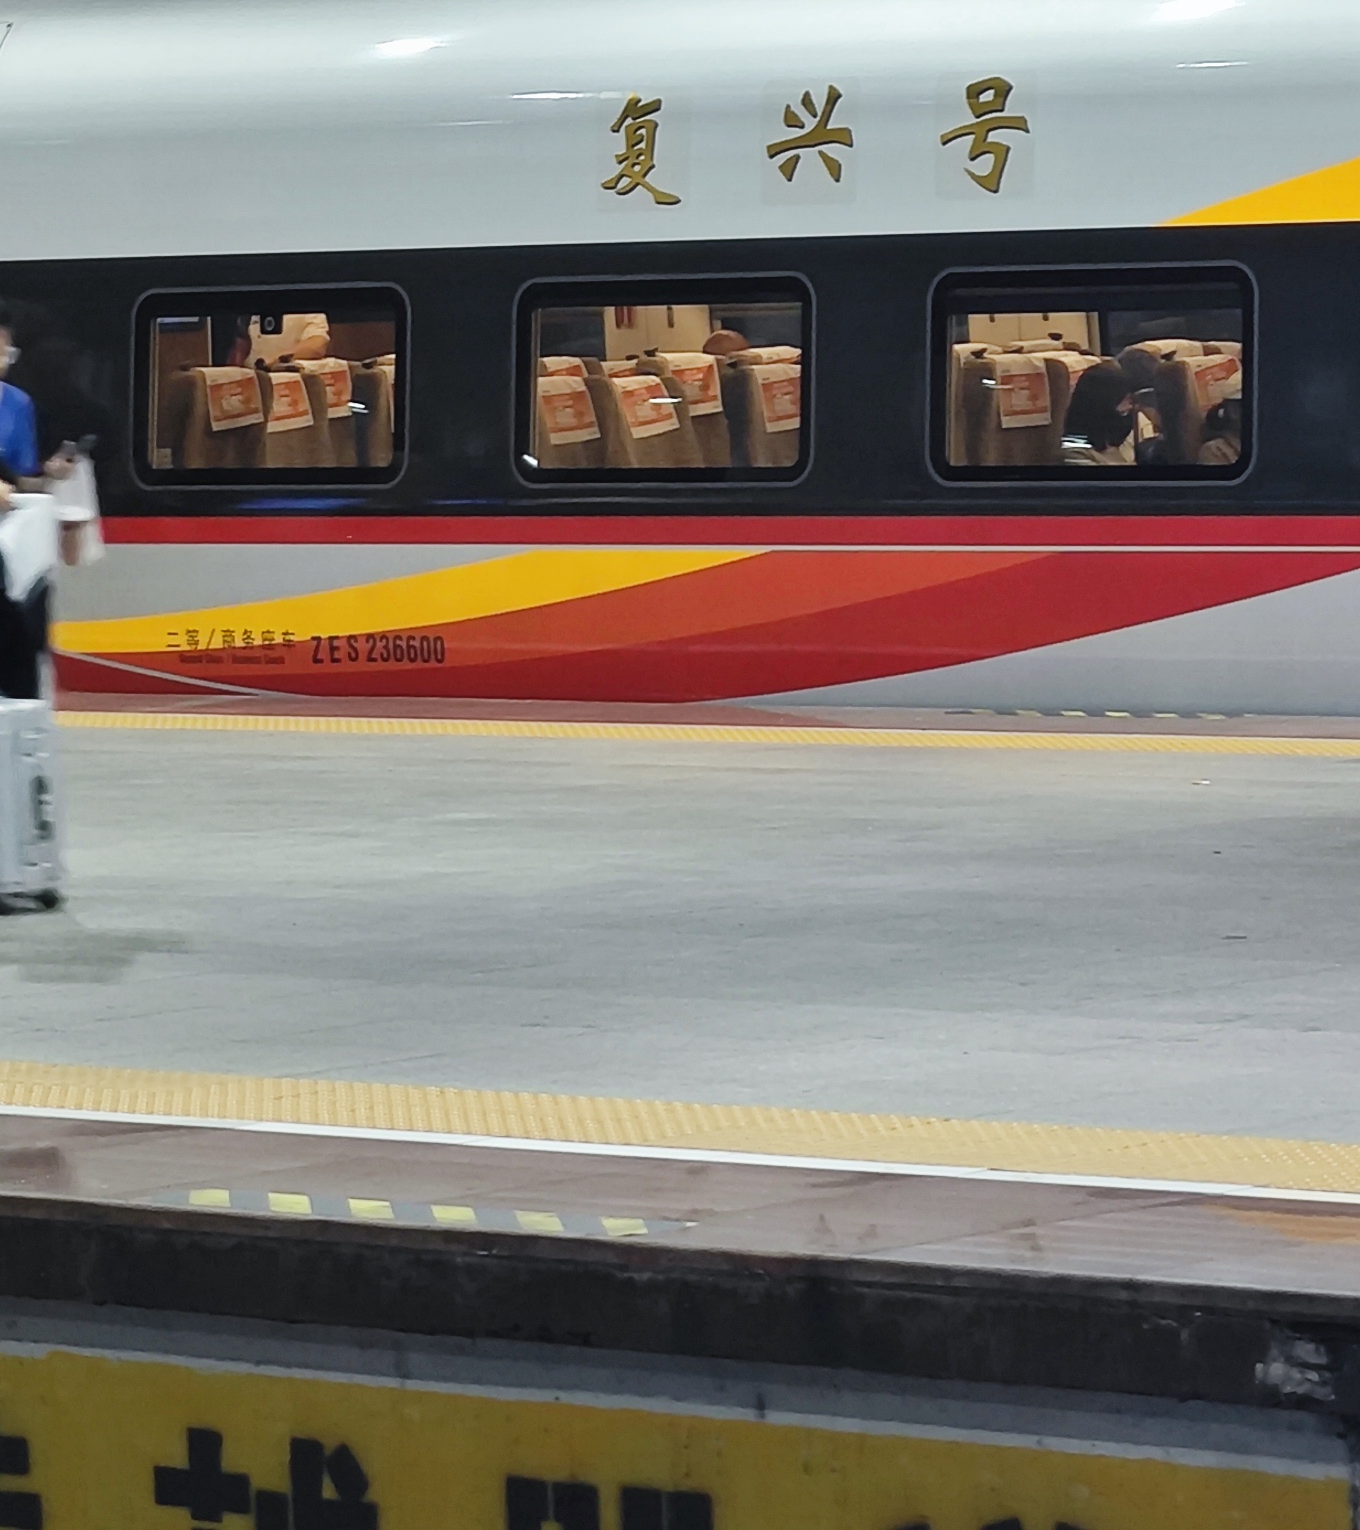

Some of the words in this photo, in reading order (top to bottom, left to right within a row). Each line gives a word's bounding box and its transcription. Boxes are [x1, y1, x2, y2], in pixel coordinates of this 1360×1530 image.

[601, 76, 1031, 206] 复兴号
[311, 635, 359, 665] ZES
[365, 634, 445, 665] 236600
